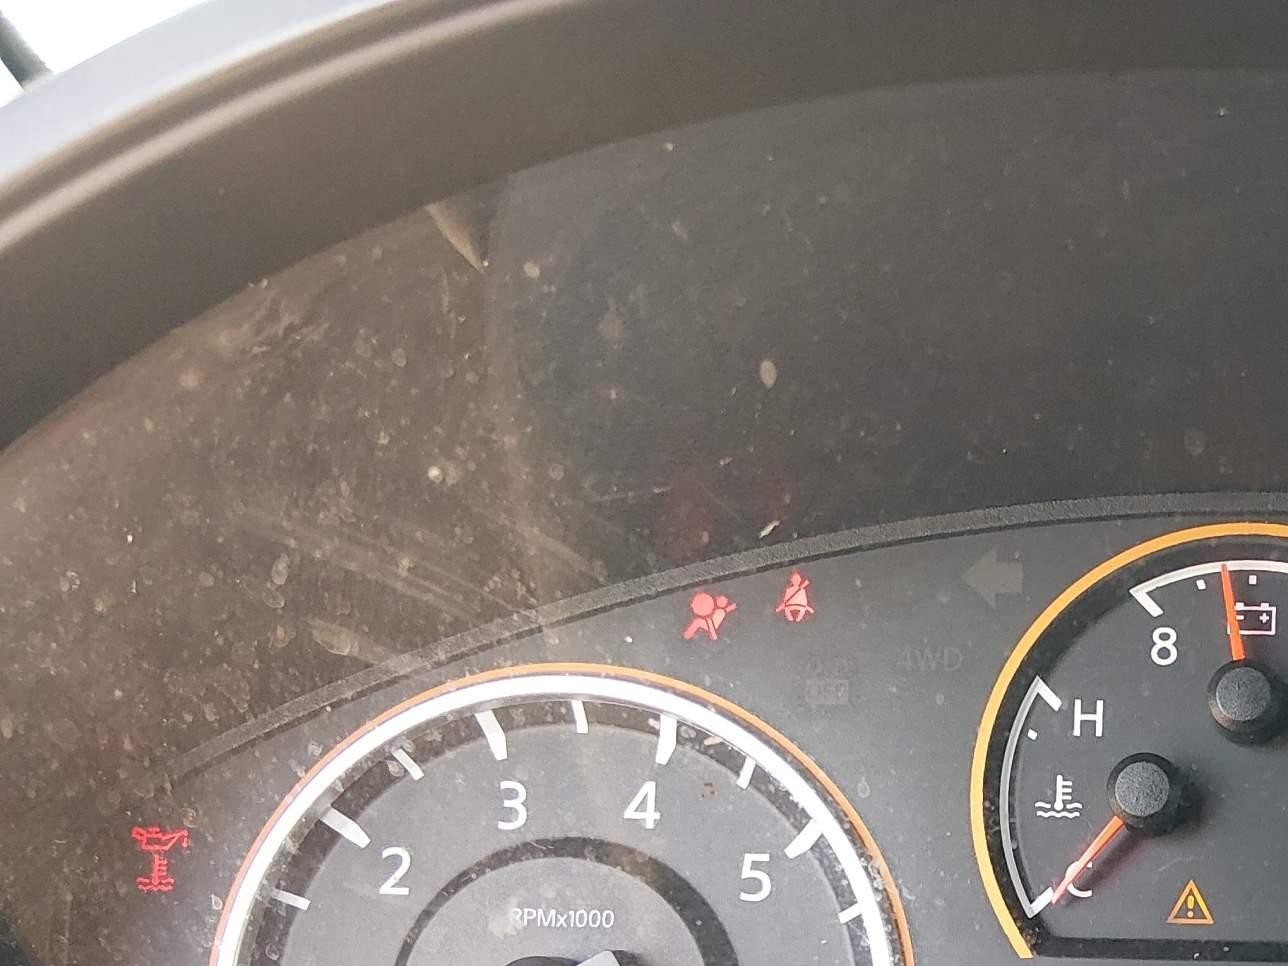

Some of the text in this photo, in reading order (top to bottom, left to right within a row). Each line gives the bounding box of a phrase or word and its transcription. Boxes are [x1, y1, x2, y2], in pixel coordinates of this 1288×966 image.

[1151, 627, 1177, 666] 8
[1073, 699, 1104, 737] H
[498, 781, 527, 830] 3
[624, 781, 661, 829] 4
[379, 847, 412, 895] 2
[739, 853, 772, 902] 5
